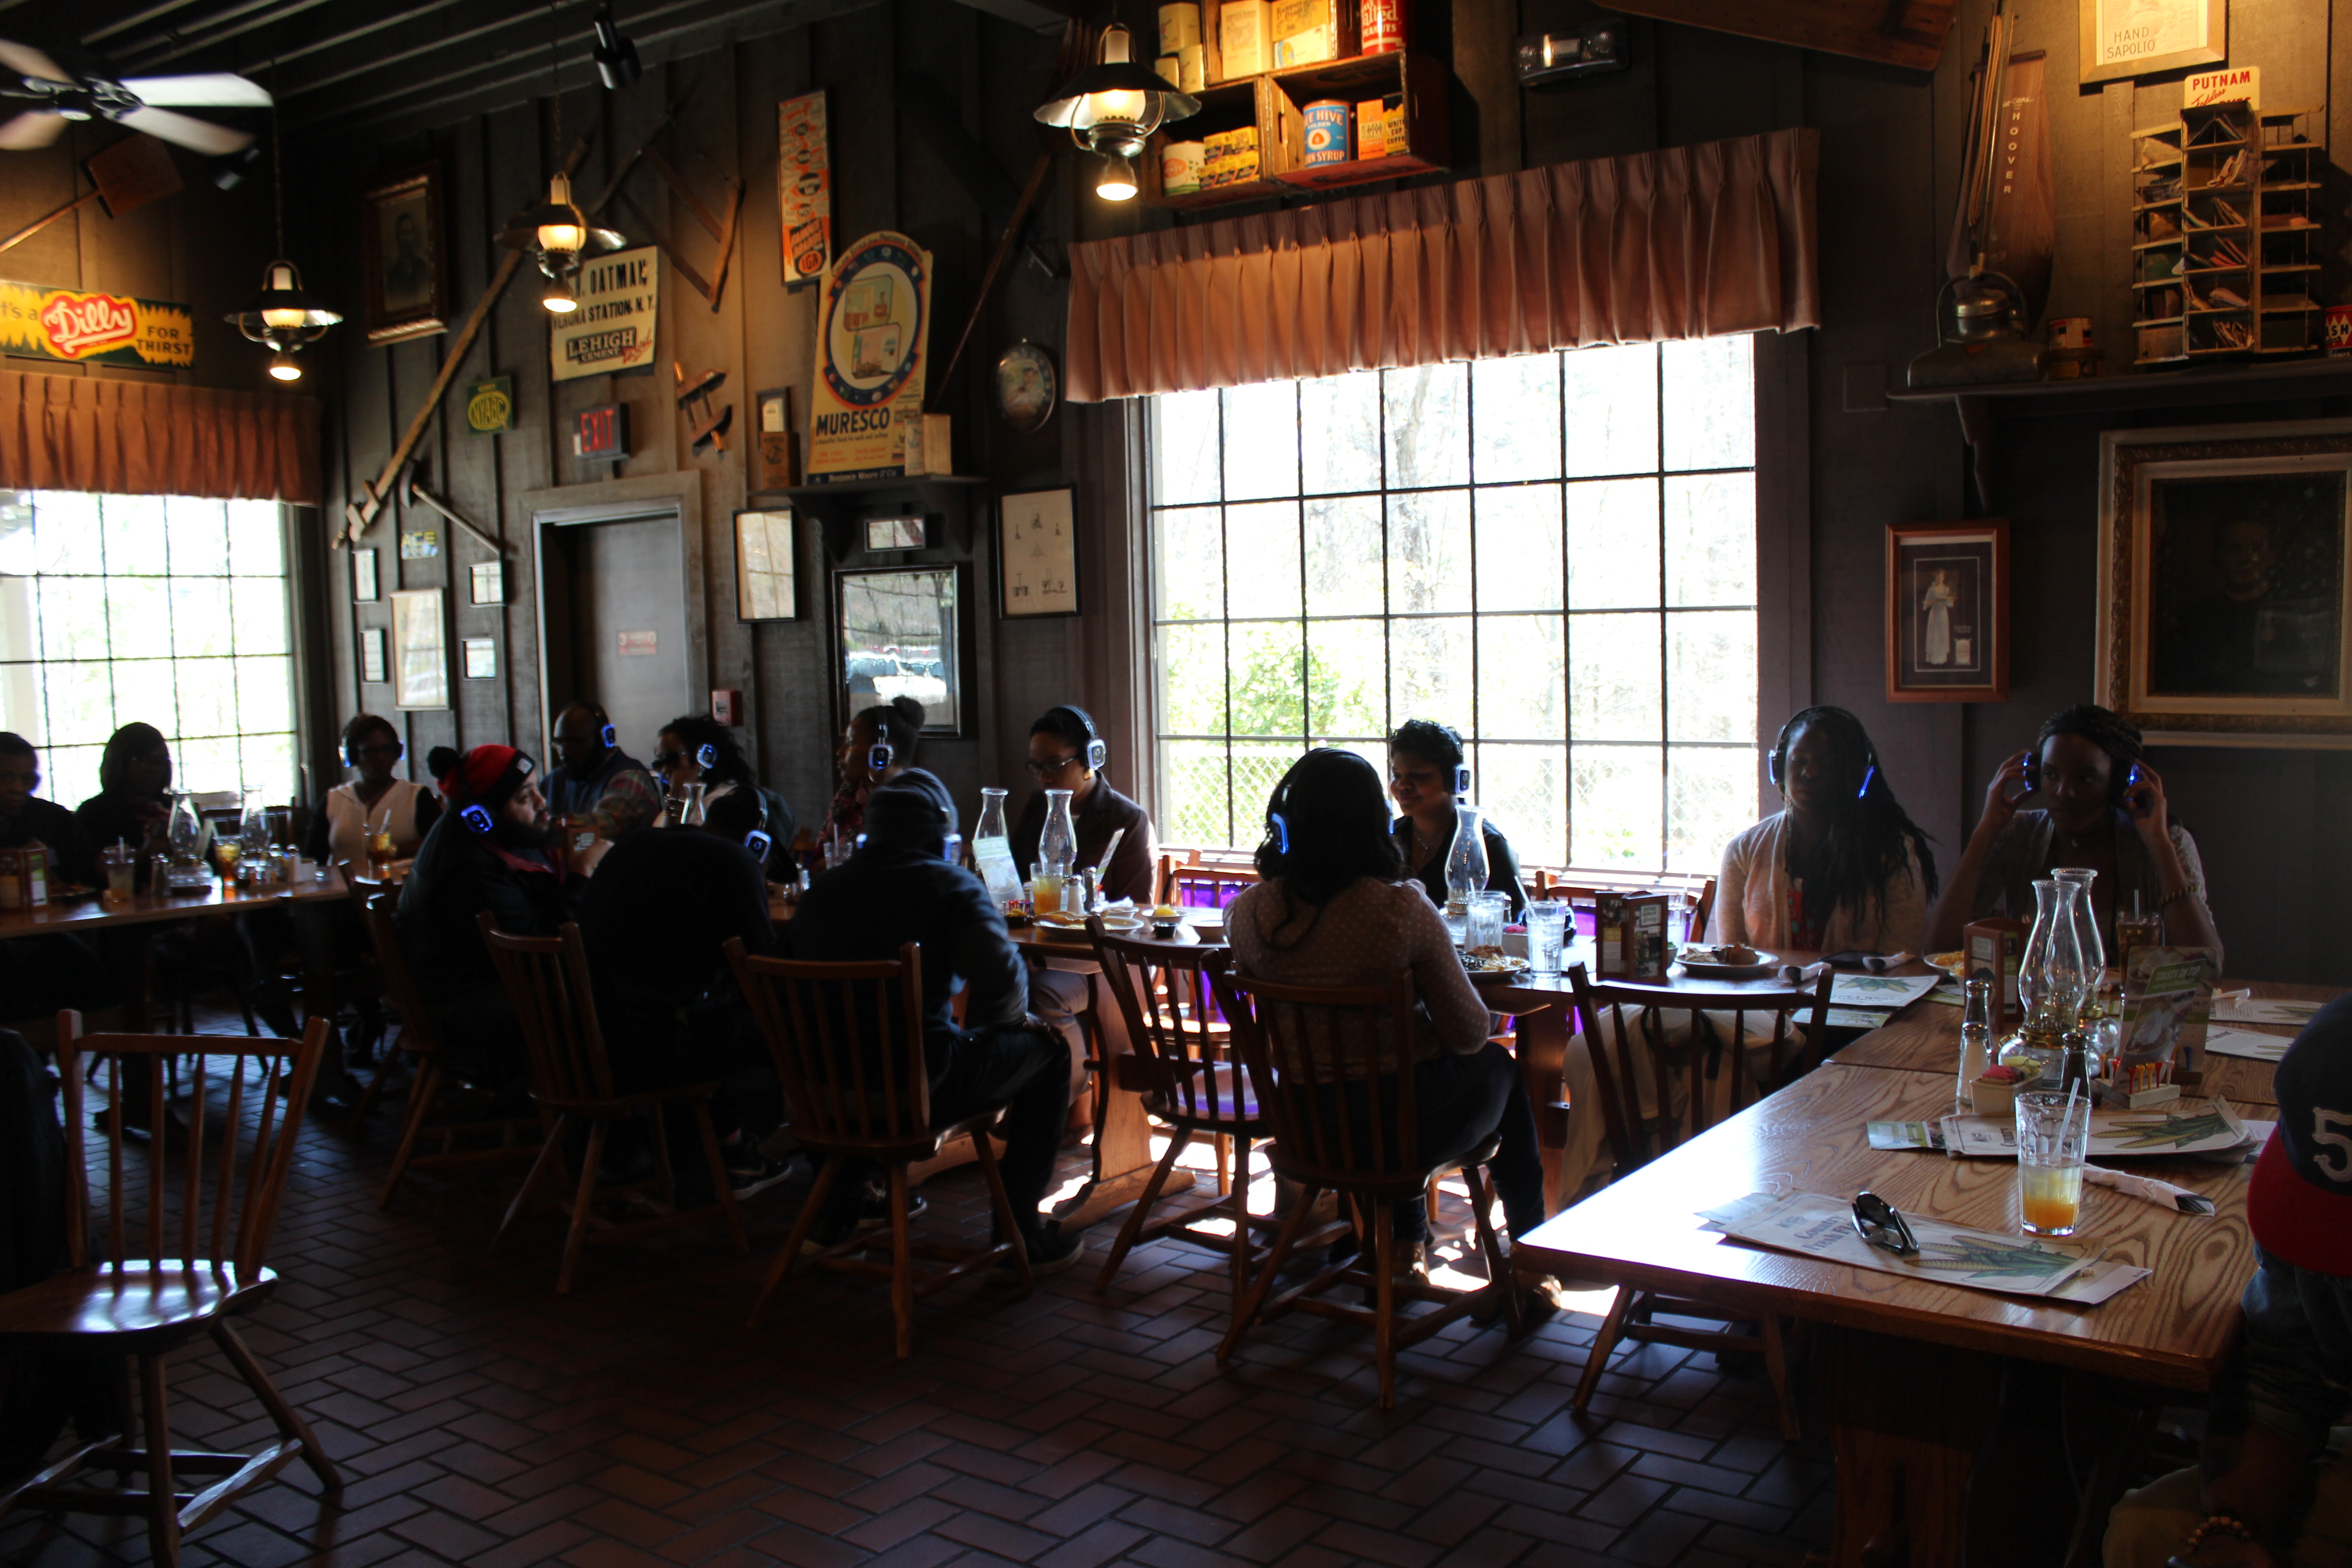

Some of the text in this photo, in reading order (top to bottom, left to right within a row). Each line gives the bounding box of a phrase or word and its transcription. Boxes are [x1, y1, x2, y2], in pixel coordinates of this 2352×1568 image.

[1362, 0, 1398, 26] alted
[2114, 27, 2149, 44] HAND
[2107, 39, 2155, 59] SAPOLIO
[2193, 71, 2250, 91] PUTNAM
[1316, 110, 1343, 127] HIVE
[1392, 127, 1402, 136] CUP
[1316, 150, 1345, 162] SYRUP
[2003, 112, 2021, 194] HOOVER
[802, 253, 818, 270] IGA
[591, 260, 647, 294] OATMAN
[0, 301, 37, 321] t's a
[43, 299, 133, 354] Dilly
[147, 327, 178, 340] FOR
[137, 339, 190, 355] THIRST
[568, 330, 635, 356] LEHIGH
[581, 348, 619, 362] CEMENT
[580, 409, 614, 453] EXIT
[816, 407, 890, 436] MURESCO
[858, 471, 878, 480] Moore
[1794, 1215, 1847, 1239] Country
[1802, 1234, 1844, 1251] Fresh
